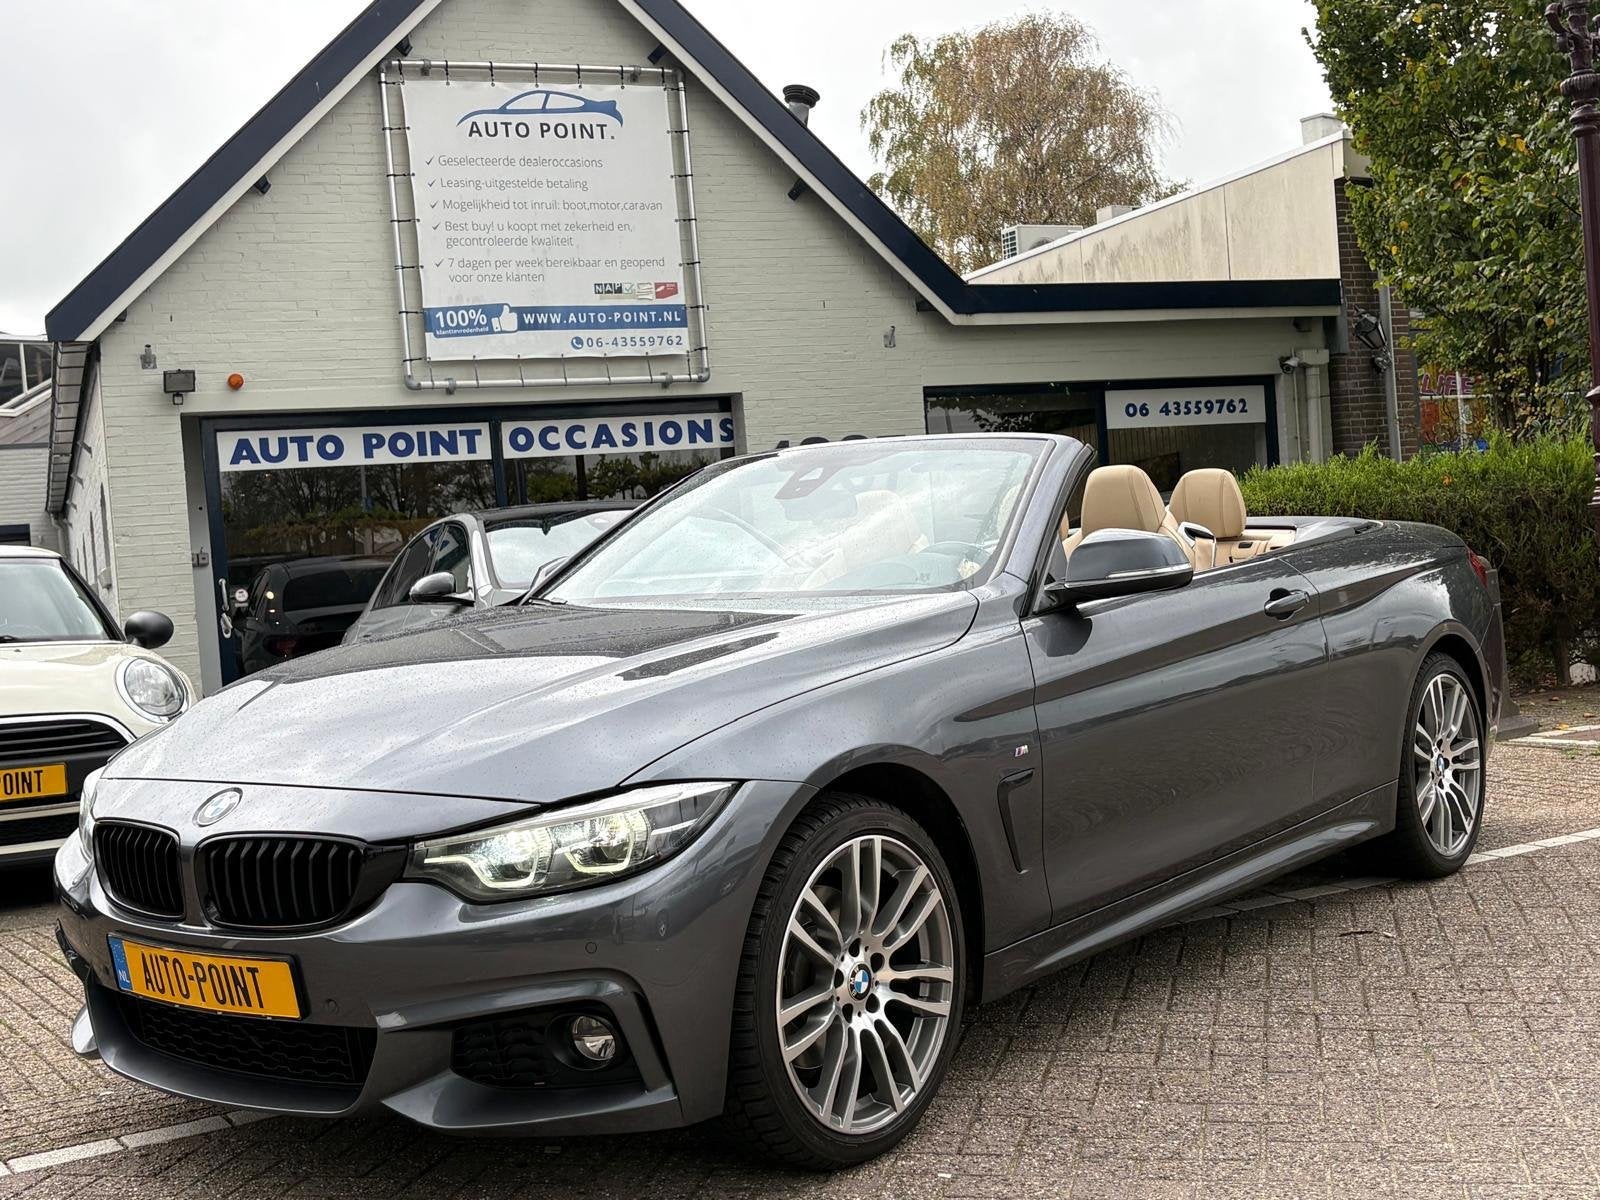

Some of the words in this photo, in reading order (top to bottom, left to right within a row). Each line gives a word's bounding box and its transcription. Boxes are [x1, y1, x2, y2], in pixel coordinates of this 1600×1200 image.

[468, 121, 530, 138] AUTO
[539, 122, 616, 140] POINT.
[438, 155, 516, 167] Geselecteerde
[519, 155, 604, 168] dealeroccasions
[440, 177, 543, 190] Leasing-uitgestelde
[546, 178, 588, 192] betaling
[442, 198, 510, 213] Mogelijkheid
[513, 200, 529, 210] tot
[531, 199, 560, 211] inruil:
[562, 199, 663, 212] boot,motor,caravan
[444, 220, 469, 232] Best
[472, 220, 494, 234] buy!
[497, 223, 504, 232] u
[507, 220, 539, 234] koopt
[541, 222, 561, 232] met
[564, 221, 615, 232] zekerheid
[446, 236, 529, 250] gecontroleerde
[531, 235, 574, 247] kwaliteit
[448, 257, 455, 268] 7
[457, 257, 492, 271] dagen
[494, 259, 512, 271] per
[515, 257, 543, 268] week
[545, 257, 601, 268] bereikbaar
[604, 259, 618, 268] en
[620, 256, 665, 270] geopend
[448, 273, 473, 283] voor
[476, 272, 503, 282] onze
[505, 272, 545, 282] klanten
[594, 282, 623, 295] NAP
[435, 308, 487, 328] 100%
[523, 311, 681, 324] WWW.AUTO-POINT.NL
[586, 335, 683, 348] 06-43559762
[1124, 402, 1150, 418] 06
[1159, 398, 1248, 416] 43559762
[508, 417, 734, 453] OCCASIONS
[229, 434, 345, 466] AUTO
[362, 428, 482, 460] POINT
[0, 769, 44, 796] OINT
[118, 969, 130, 984] NL
[140, 950, 264, 1009] AUTO-POINT
